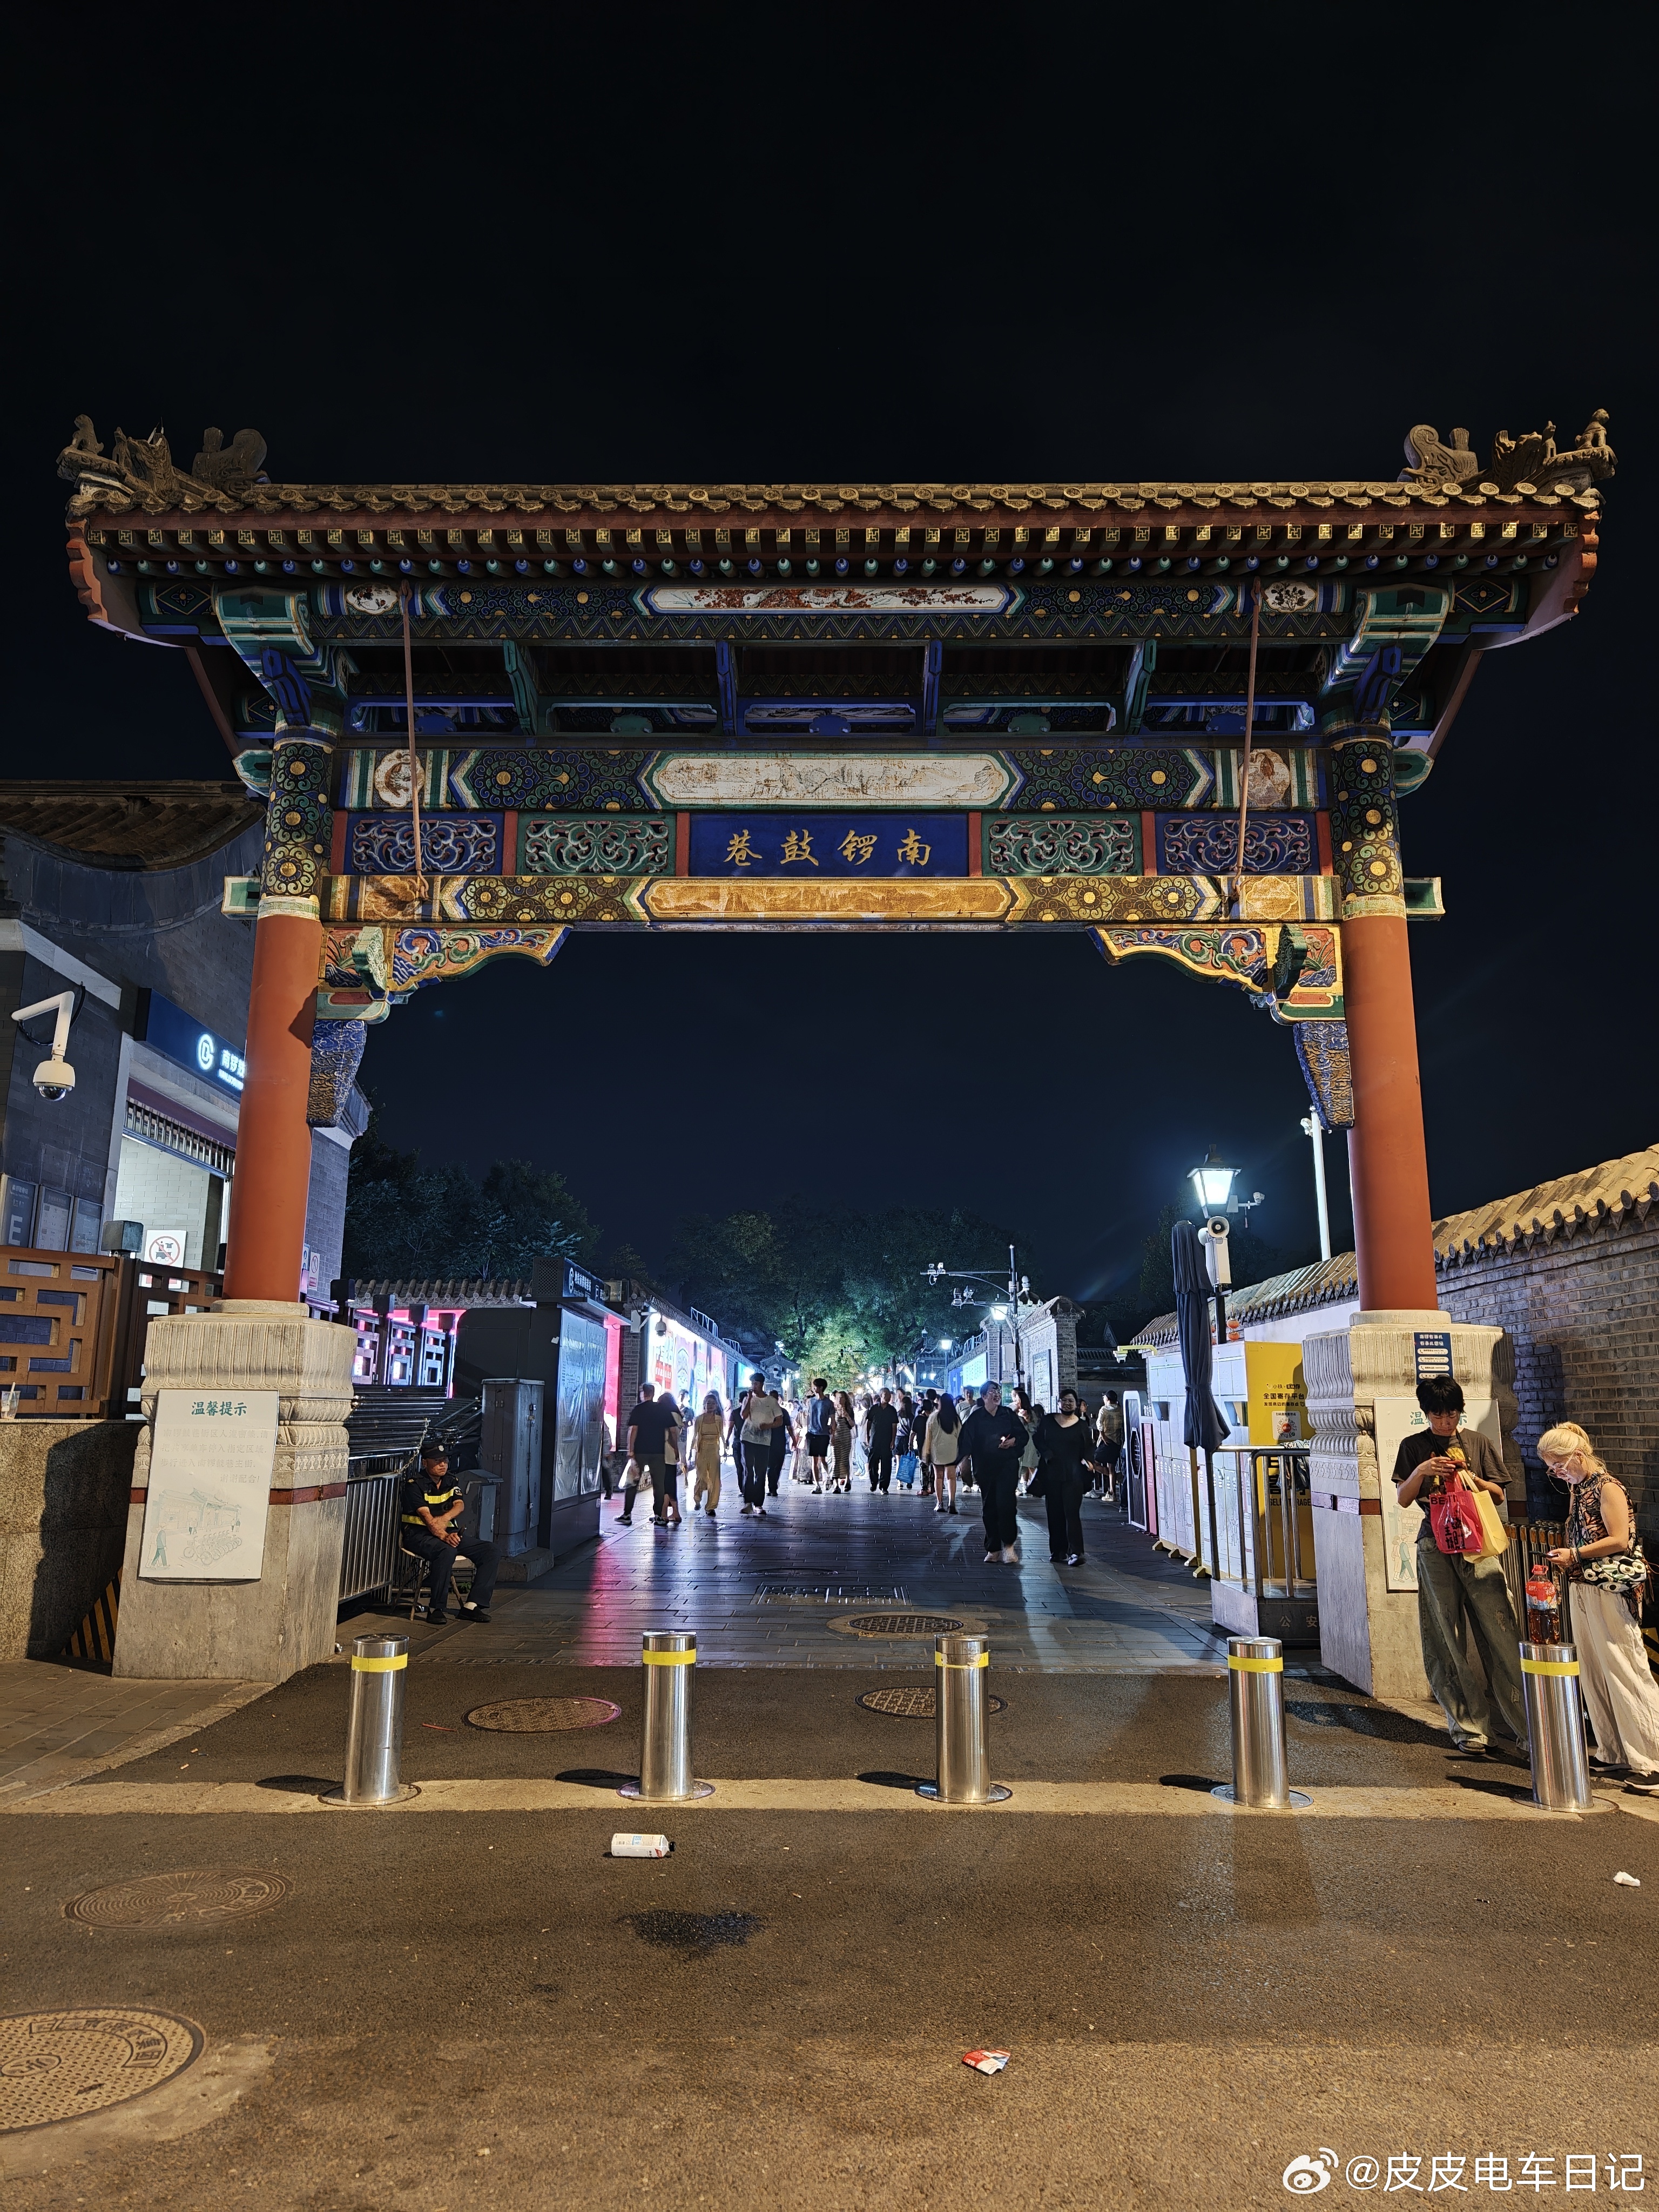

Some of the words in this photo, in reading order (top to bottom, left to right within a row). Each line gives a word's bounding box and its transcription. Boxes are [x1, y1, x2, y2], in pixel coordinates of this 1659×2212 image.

[723, 828, 932, 866] 南锣鼓巷
[8, 1214, 23, 1246] E
[191, 1400, 247, 1417] 温馨提示
